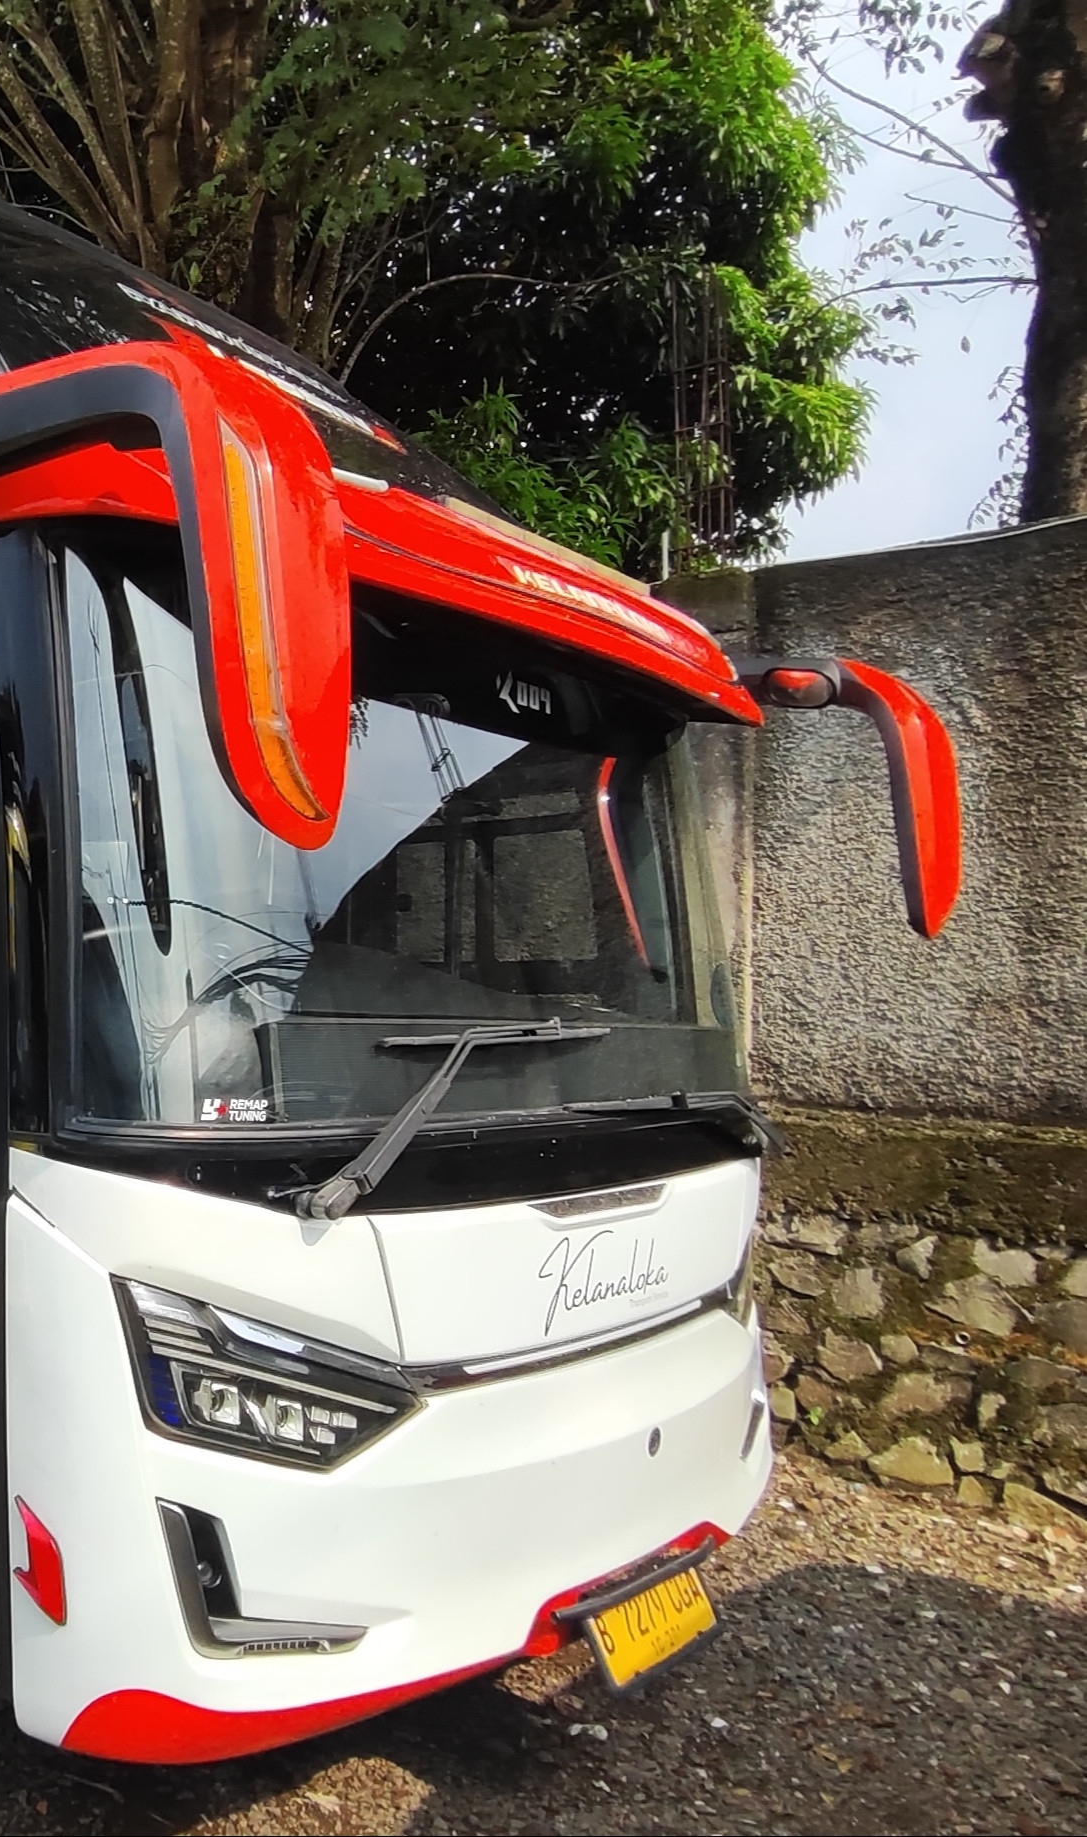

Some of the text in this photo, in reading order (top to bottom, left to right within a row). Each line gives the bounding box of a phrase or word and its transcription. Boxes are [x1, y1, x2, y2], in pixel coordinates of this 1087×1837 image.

[229, 1111, 267, 1122] TUNING
[230, 1099, 268, 1110] REMAP
[539, 1230, 669, 1337] Kelanaloka
[593, 1614, 615, 1656] B
